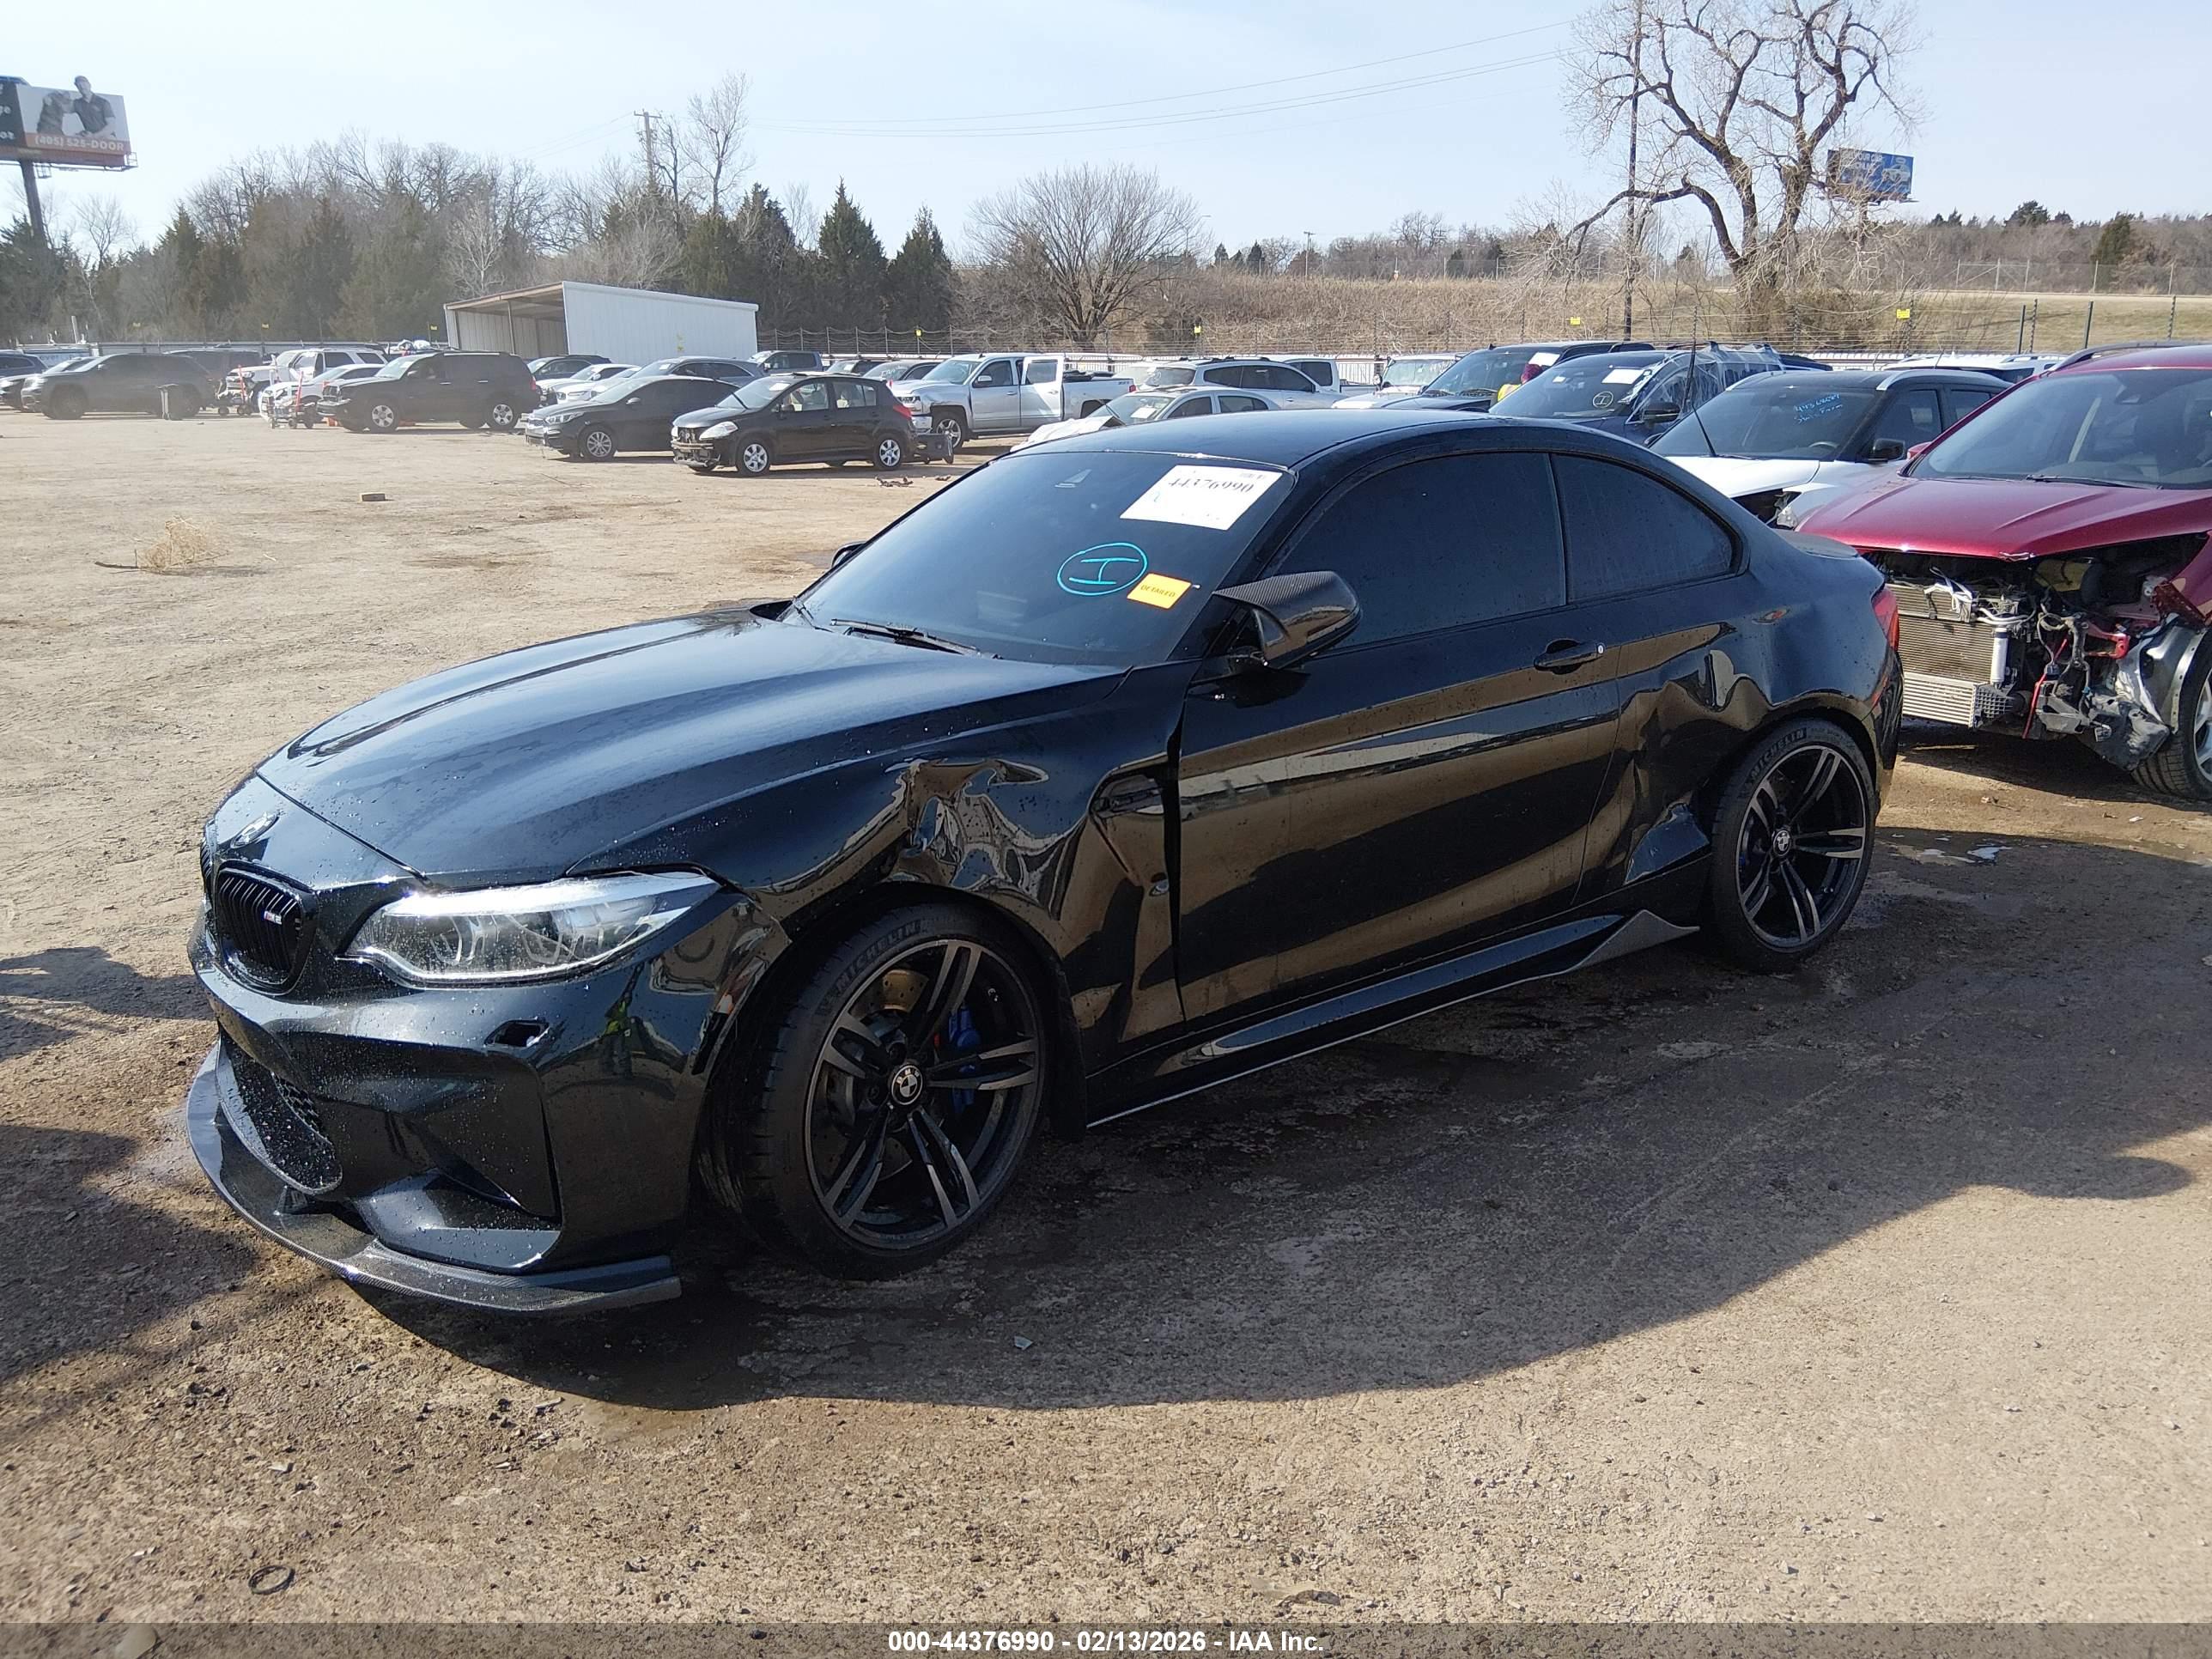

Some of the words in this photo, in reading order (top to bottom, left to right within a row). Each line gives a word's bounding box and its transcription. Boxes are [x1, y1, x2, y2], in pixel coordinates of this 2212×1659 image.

[1169, 478, 1255, 493] 44376990
[1140, 584, 1176, 598] DETAILED
[1750, 728, 1805, 779] MICHELIN
[835, 920, 921, 994] MICHELIN
